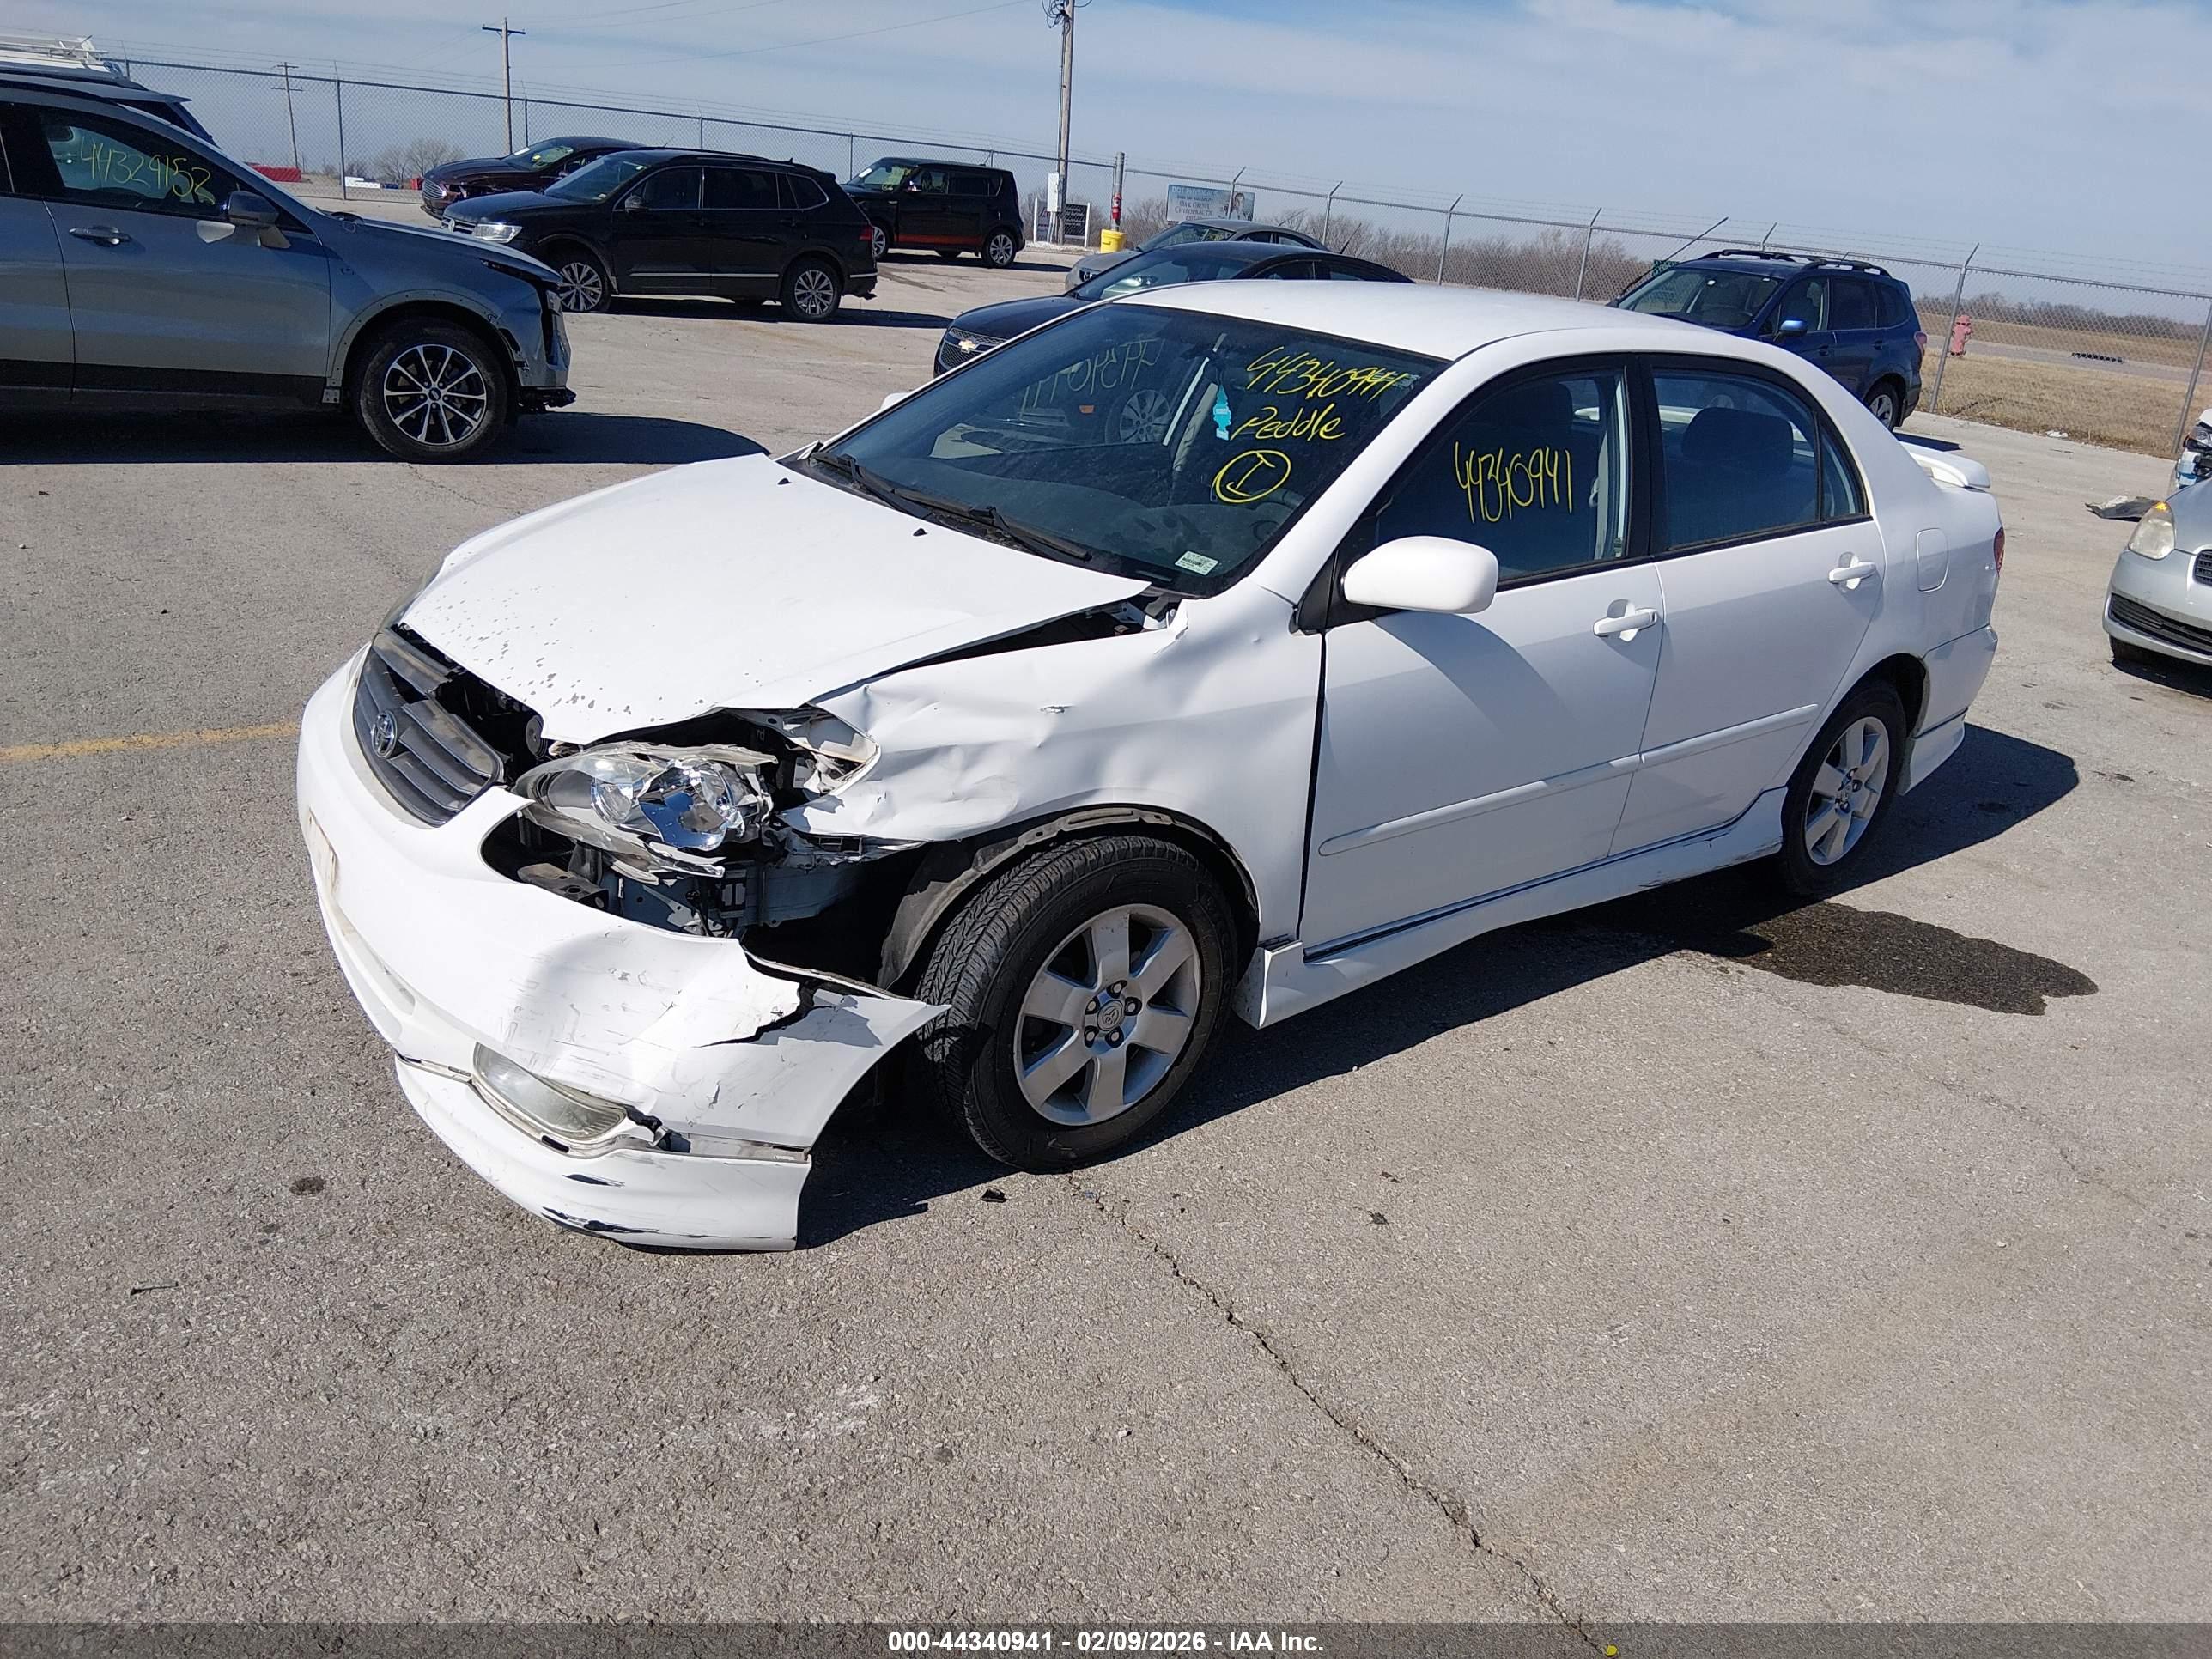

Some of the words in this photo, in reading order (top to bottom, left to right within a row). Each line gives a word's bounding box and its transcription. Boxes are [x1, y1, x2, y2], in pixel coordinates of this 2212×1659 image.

[81, 136, 216, 205] 44329152
[1247, 346, 1407, 403] 44340941
[1230, 404, 1345, 441] Peddle
[1455, 441, 1572, 524] 44340941
